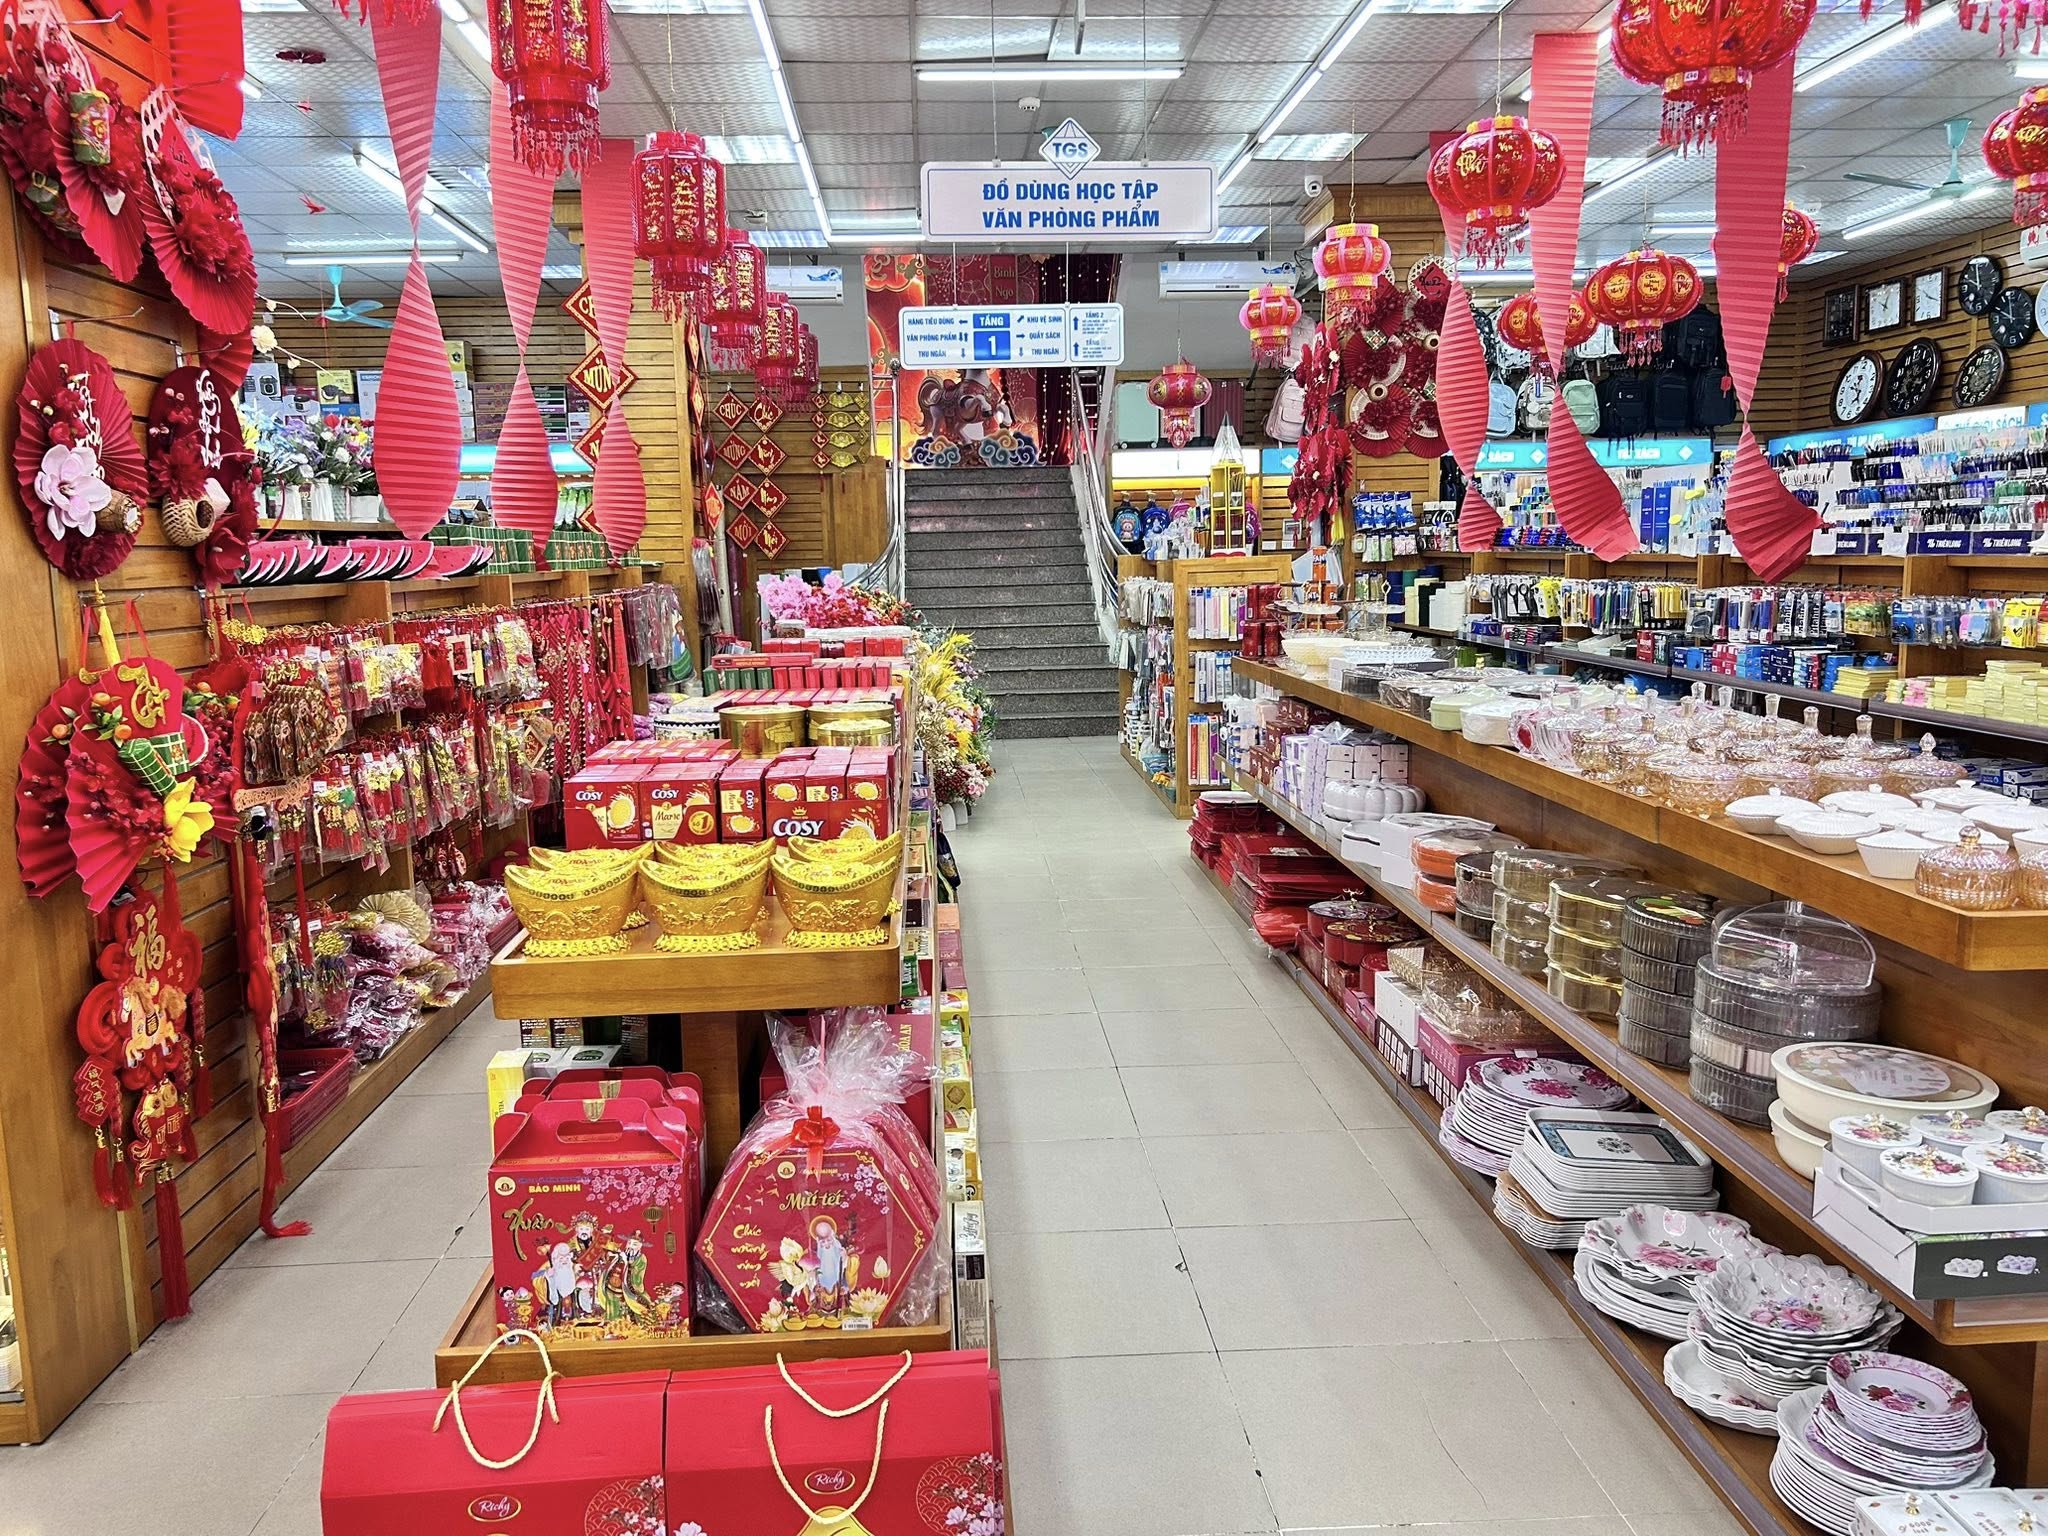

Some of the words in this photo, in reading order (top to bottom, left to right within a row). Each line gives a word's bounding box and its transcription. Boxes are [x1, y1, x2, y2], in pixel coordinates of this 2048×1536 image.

[1053, 142, 1087, 159] TGS
[983, 178, 1009, 200] ĐỒ
[1016, 179, 1069, 200] DÙNG
[1076, 183, 1115, 203] HỌC
[1122, 179, 1159, 203] TẬP
[983, 208, 1022, 228] VĂN
[1029, 207, 1096, 228] PHÒNG
[1102, 203, 1160, 227] PHẨM
[980, 313, 1004, 326] TẦNG
[1040, 315, 1047, 324] VỆ
[1046, 331, 1061, 339] SÁCH
[988, 335, 996, 355] 1
[583, 357, 613, 394] MỪN
[720, 400, 741, 419] CHÚC
[723, 440, 746, 461] MỪNG
[575, 790, 602, 801] COSY
[652, 788, 679, 799] COSY
[745, 789, 755, 810] COSY
[830, 785, 839, 801] COS
[655, 811, 680, 821] Marie
[773, 818, 824, 837] COSY
[128, 903, 166, 979] 福
[529, 1183, 550, 1193] BẢO
[552, 1184, 581, 1193] MINH
[779, 1189, 818, 1211] Mứt
[820, 1189, 845, 1206] tết
[733, 1223, 762, 1239] Chúc
[731, 1242, 769, 1261] mừng
[815, 1470, 845, 1490] Richy
[479, 1496, 511, 1518] Richy
